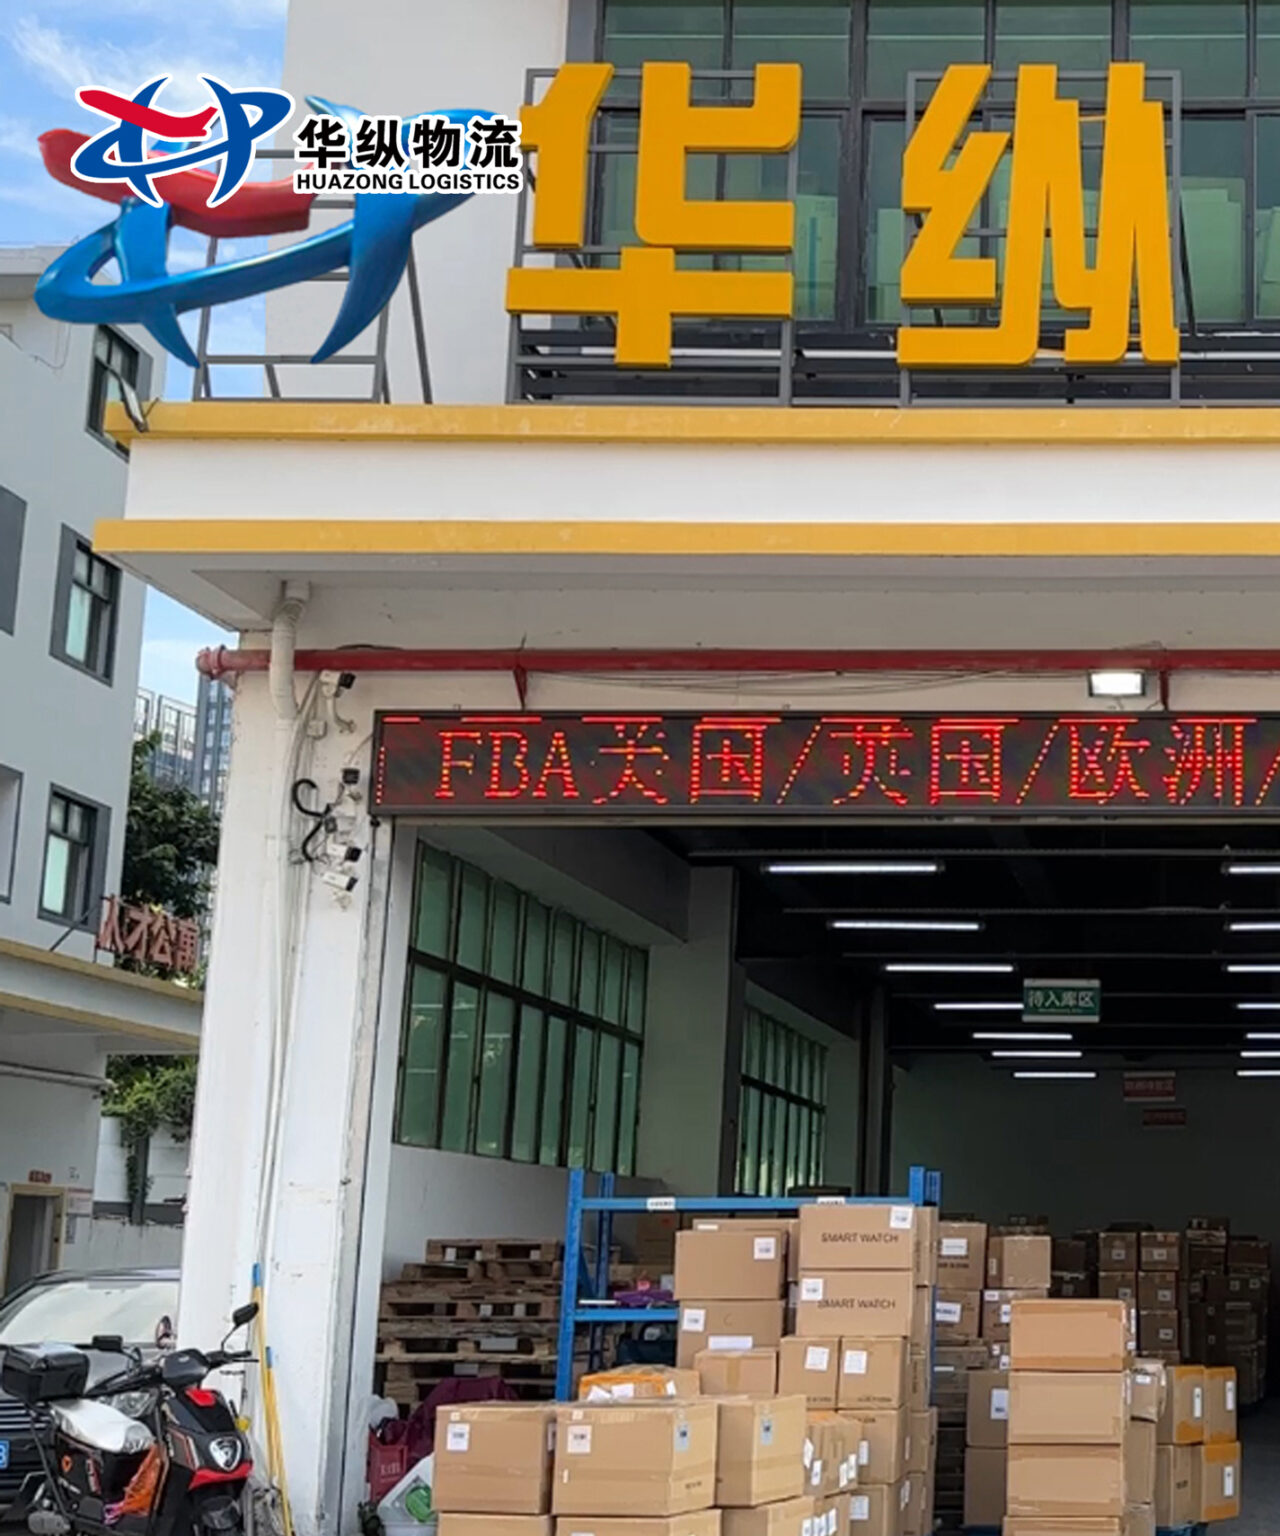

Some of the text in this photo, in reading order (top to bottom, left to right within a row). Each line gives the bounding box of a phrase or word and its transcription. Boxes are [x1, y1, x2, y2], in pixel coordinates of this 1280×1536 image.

[1028, 990, 1095, 1008] 待入库区
[821, 1232, 899, 1244] SMART WATCH
[817, 1299, 896, 1310] SMART WATCH
